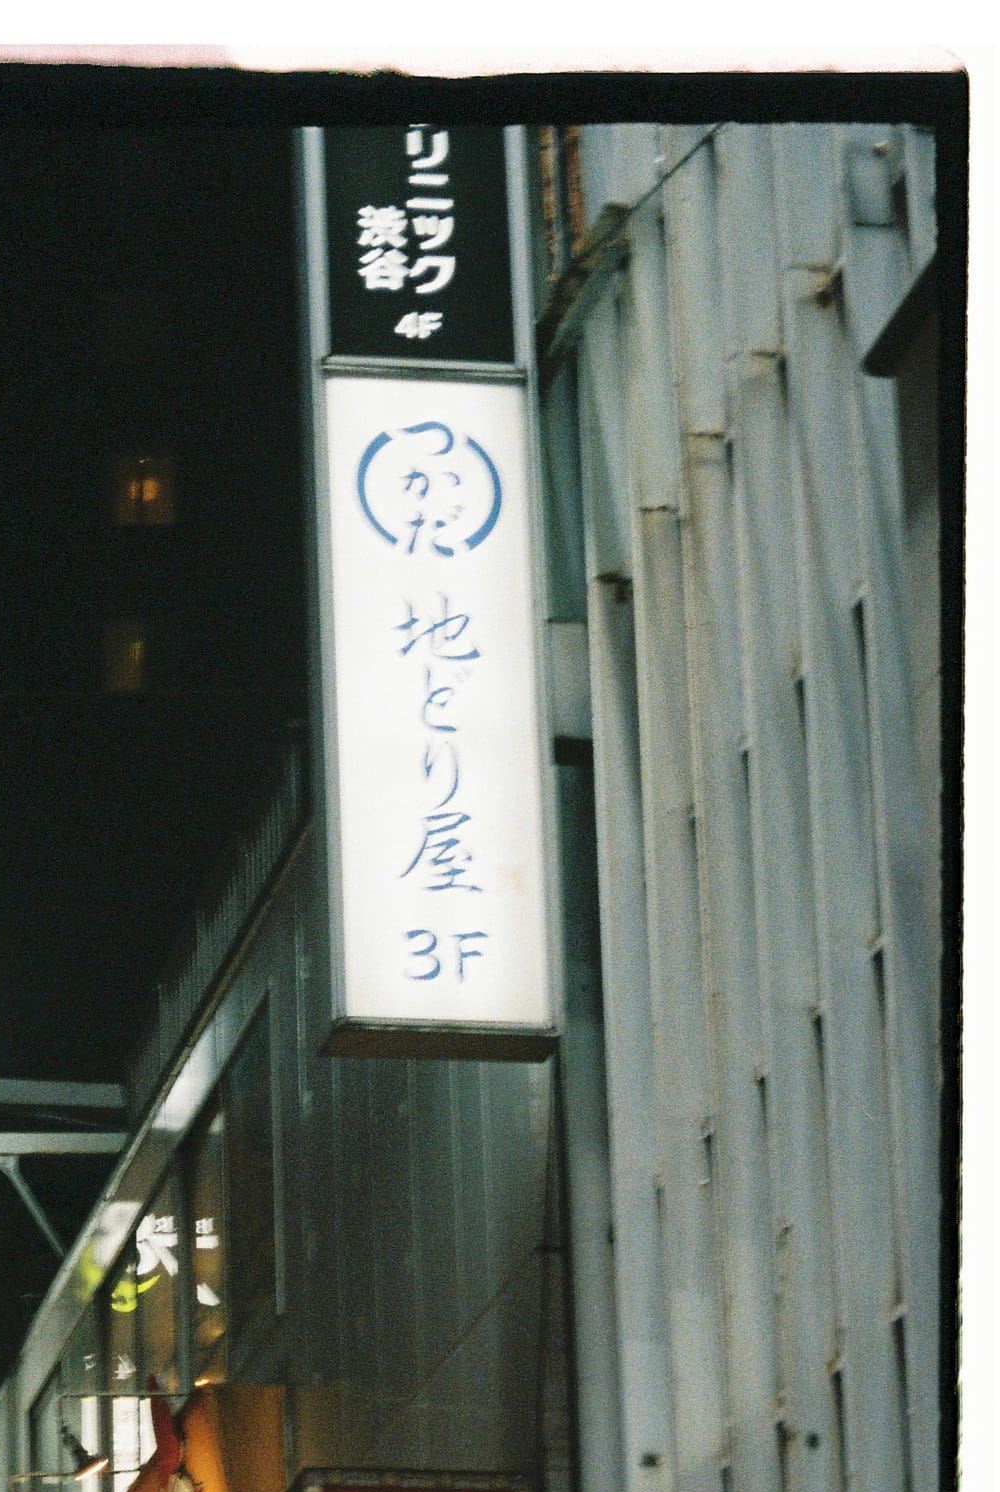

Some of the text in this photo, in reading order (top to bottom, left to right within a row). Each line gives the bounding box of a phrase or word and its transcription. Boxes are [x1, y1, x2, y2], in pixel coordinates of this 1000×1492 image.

[357, 205, 408, 291] 渋谷
[405, 123, 456, 294] リニック
[395, 311, 443, 339] 4F
[399, 421, 461, 556] つかだ
[393, 591, 483, 892] 地どり屋
[403, 928, 489, 982] 3F
